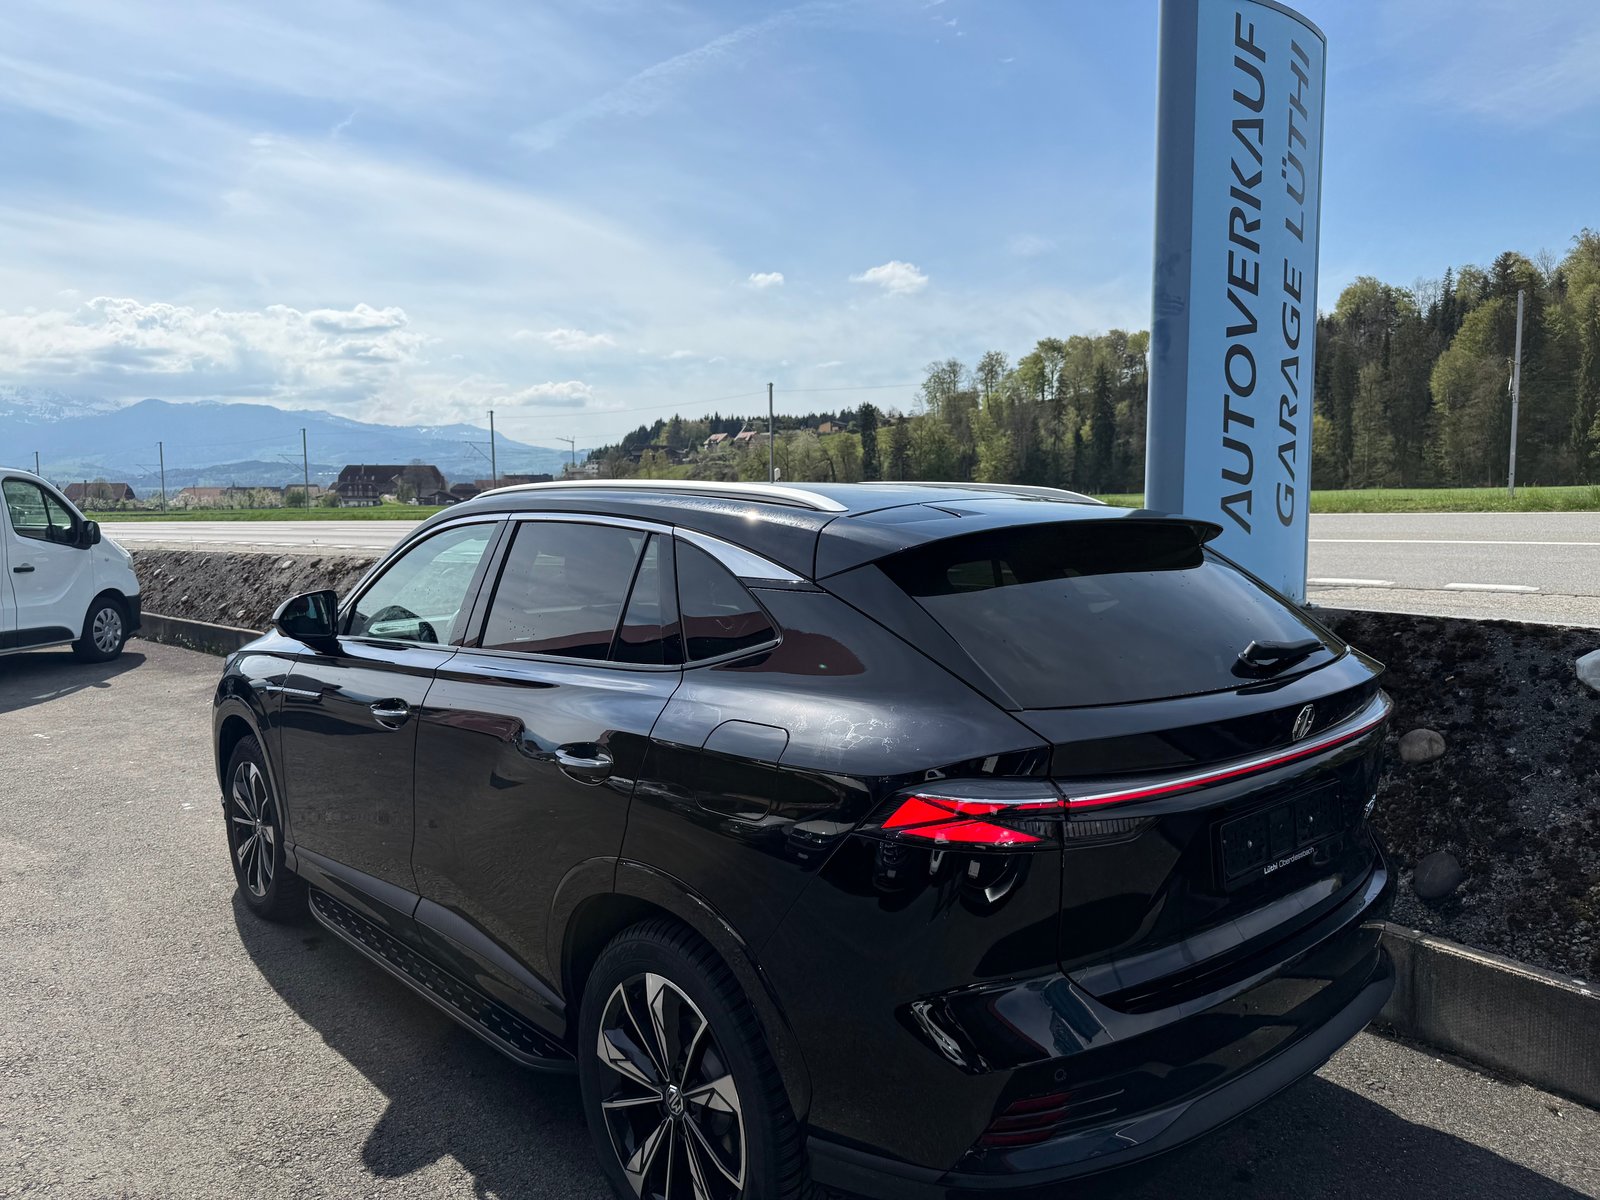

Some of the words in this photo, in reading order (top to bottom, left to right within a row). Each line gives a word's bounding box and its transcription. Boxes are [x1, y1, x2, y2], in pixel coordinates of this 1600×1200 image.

[1220, 11, 1266, 536] AUTOVERKAUF
[1281, 38, 1310, 243] LÜTHI
[1276, 258, 1302, 527] GARAGE
